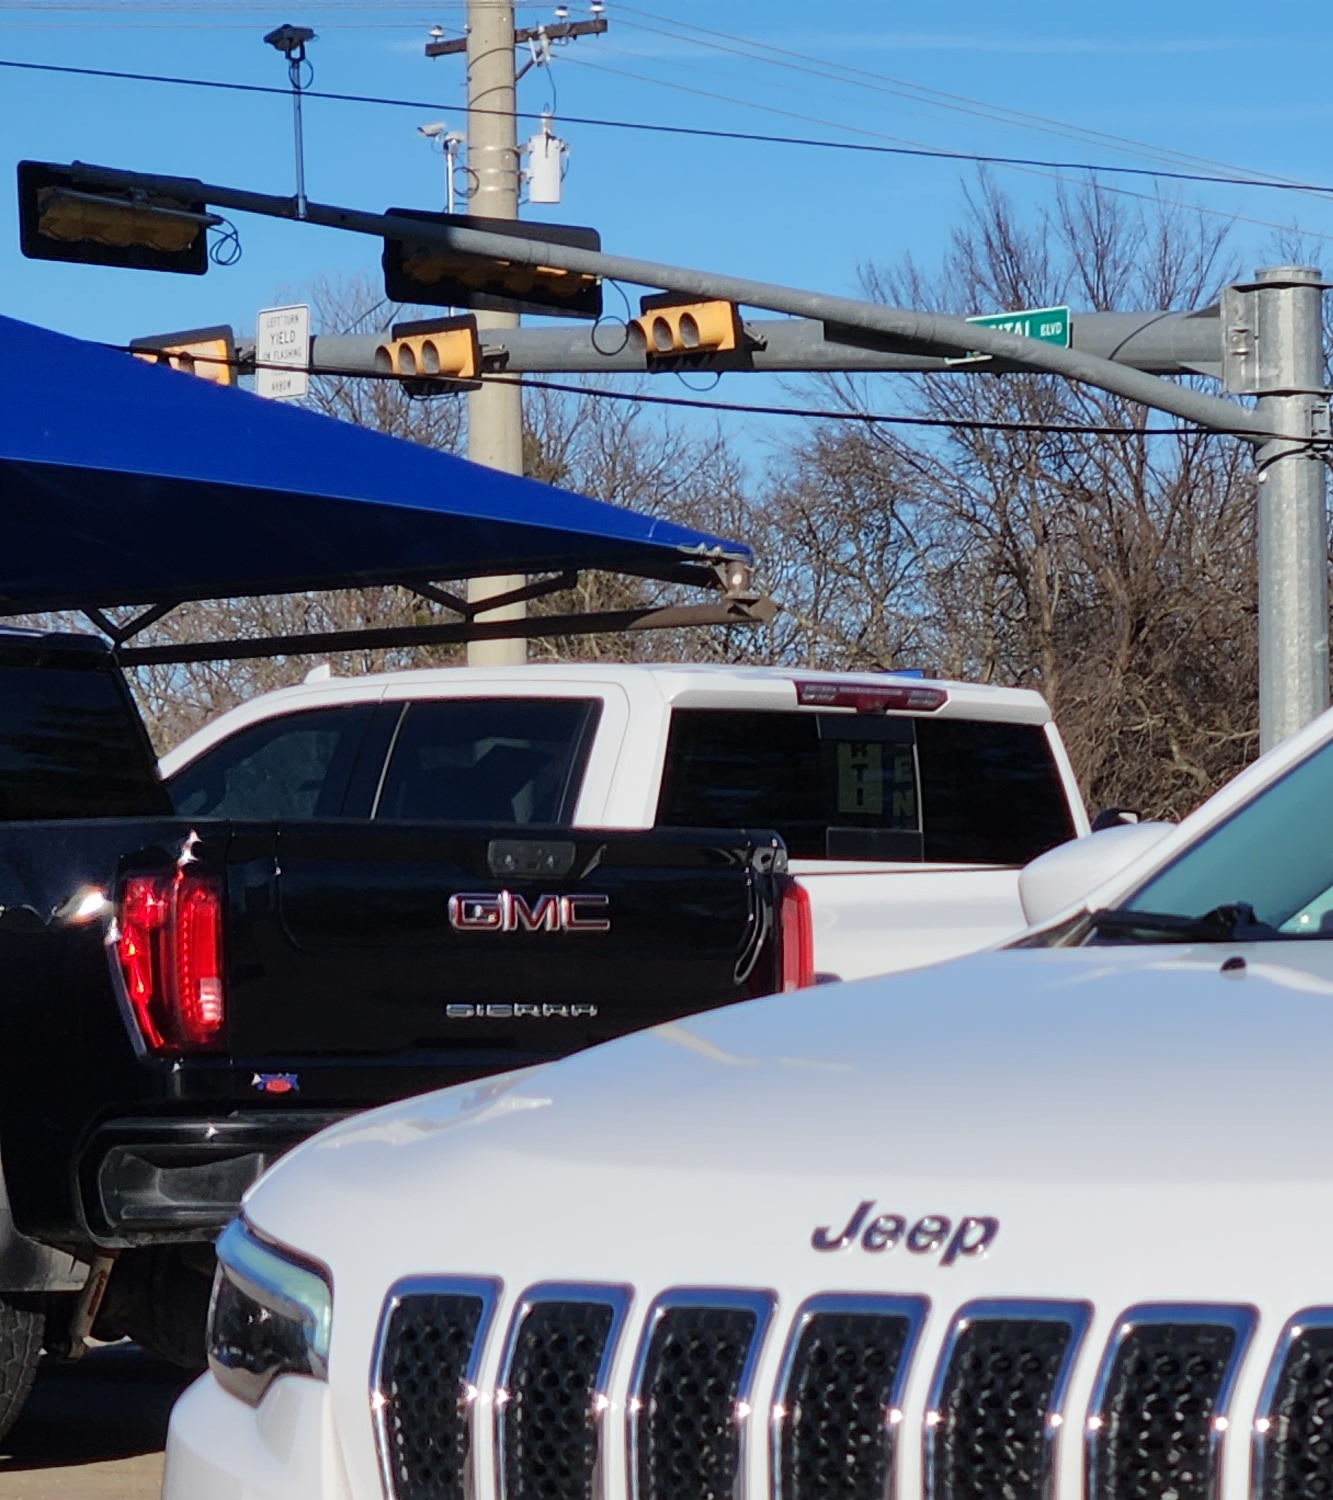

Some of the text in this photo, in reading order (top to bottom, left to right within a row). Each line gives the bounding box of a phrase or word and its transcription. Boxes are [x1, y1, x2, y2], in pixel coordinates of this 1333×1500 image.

[267, 316, 281, 328] LEFT
[1040, 321, 1063, 337] BLVD
[270, 330, 296, 346] YIELD
[273, 347, 302, 361] FLASHING
[448, 889, 611, 932] GMC
[446, 1002, 599, 1018] SIERRA
[810, 1199, 1001, 1268] Jeep
